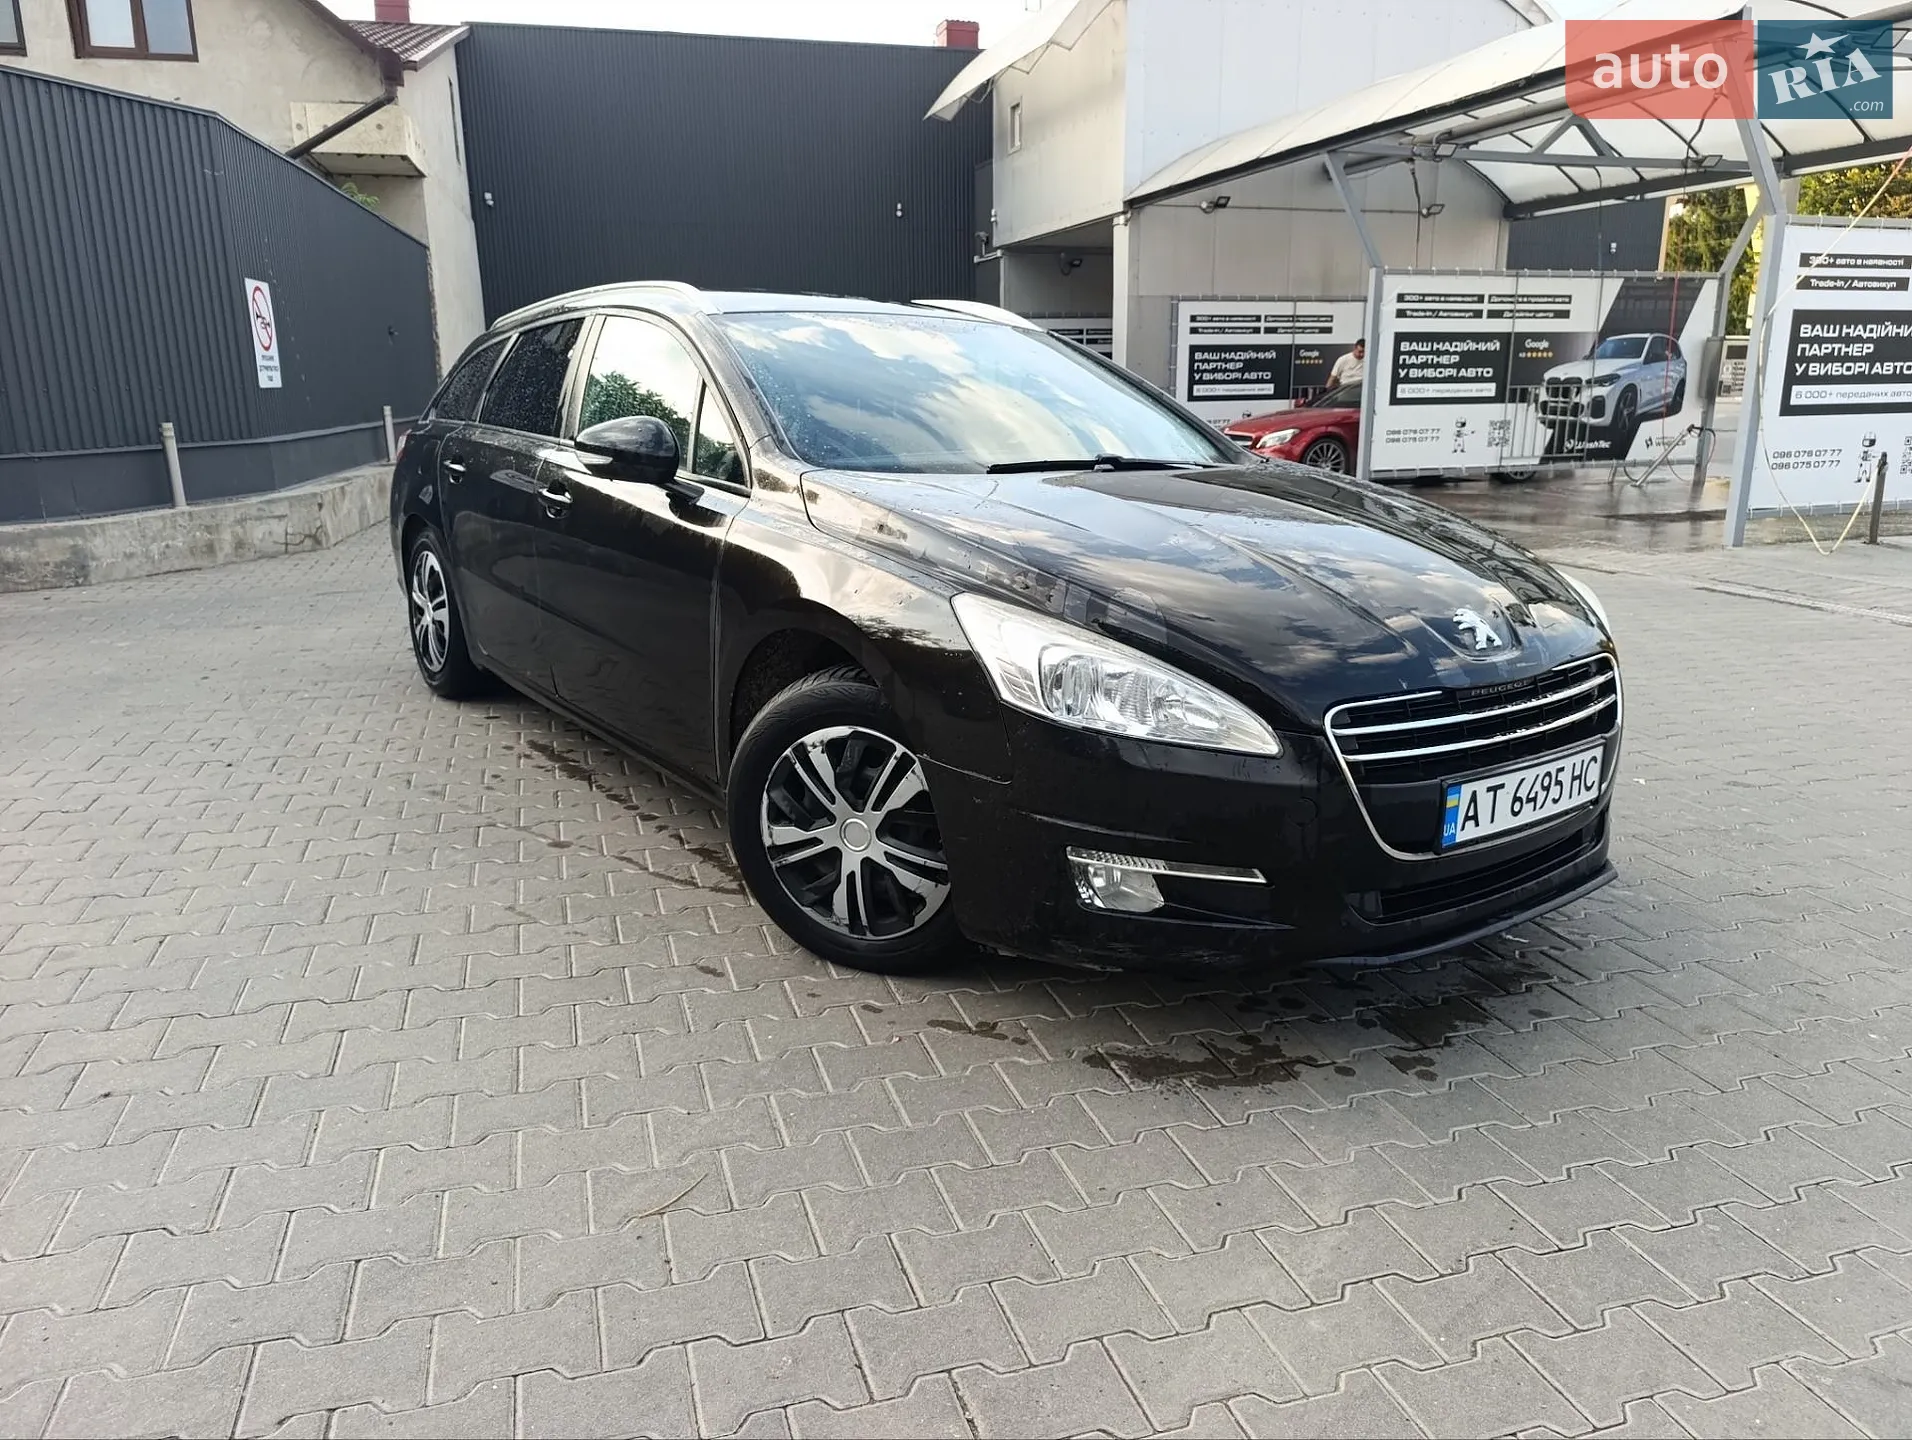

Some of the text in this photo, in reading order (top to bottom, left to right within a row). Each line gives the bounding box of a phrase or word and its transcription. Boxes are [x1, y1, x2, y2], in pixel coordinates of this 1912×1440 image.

[1863, 258, 1905, 266] наявності
[1810, 279, 1844, 288] Trade-in
[1852, 280, 1897, 290] Автовикуп
[1799, 321, 1912, 339] ВАШ НАДІЙНИ
[1400, 339, 1500, 352] ВАШ НАДІЙНИЙ
[1525, 338, 1549, 350] Google
[1797, 343, 1874, 356] ПАРТНЕР
[1194, 350, 1276, 360] ВАШ НАДІЙНИЙ
[1399, 355, 1459, 364] ПАРТНЕР
[1194, 361, 1244, 370] ПАРТНЕР
[1795, 362, 1912, 376] У ВИБОРІ АВТО
[1193, 371, 1272, 381] У ВИБОРІ АВТО
[1398, 368, 1493, 378] У ВИБОРІ АВТО
[1795, 390, 1803, 399] 6
[1835, 391, 1888, 400] переданих
[1814, 449, 1828, 457] 07
[1813, 460, 1826, 468] 07
[1460, 756, 1598, 831] AT 6495 HC
[1443, 822, 1456, 837] UA
